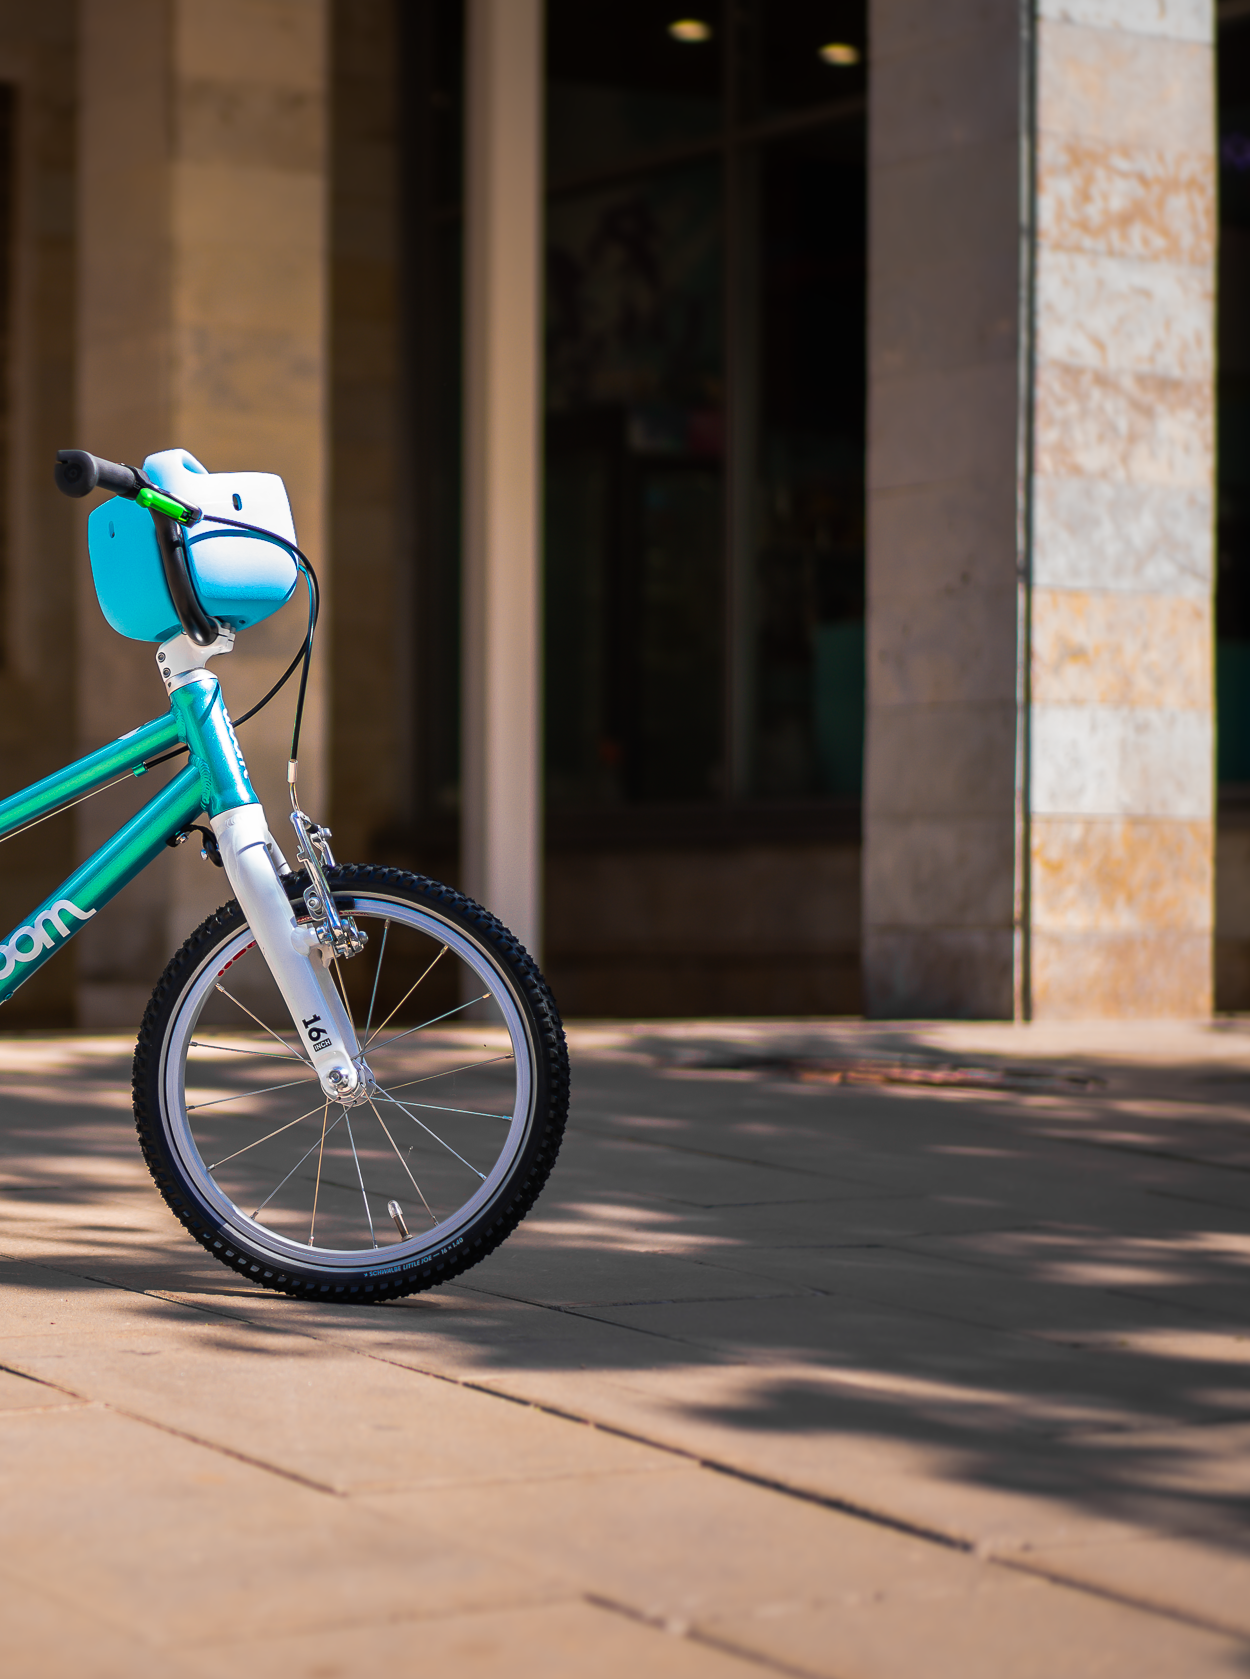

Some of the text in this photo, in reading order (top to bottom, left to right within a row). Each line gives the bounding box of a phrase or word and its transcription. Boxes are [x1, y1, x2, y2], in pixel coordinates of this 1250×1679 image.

[302, 1014, 327, 1042] 16
[314, 1039, 331, 1051] INCH
[369, 1266, 401, 1277] SCHWALBE
[403, 1260, 420, 1270] LITTLE
[421, 1255, 432, 1264] JOE
